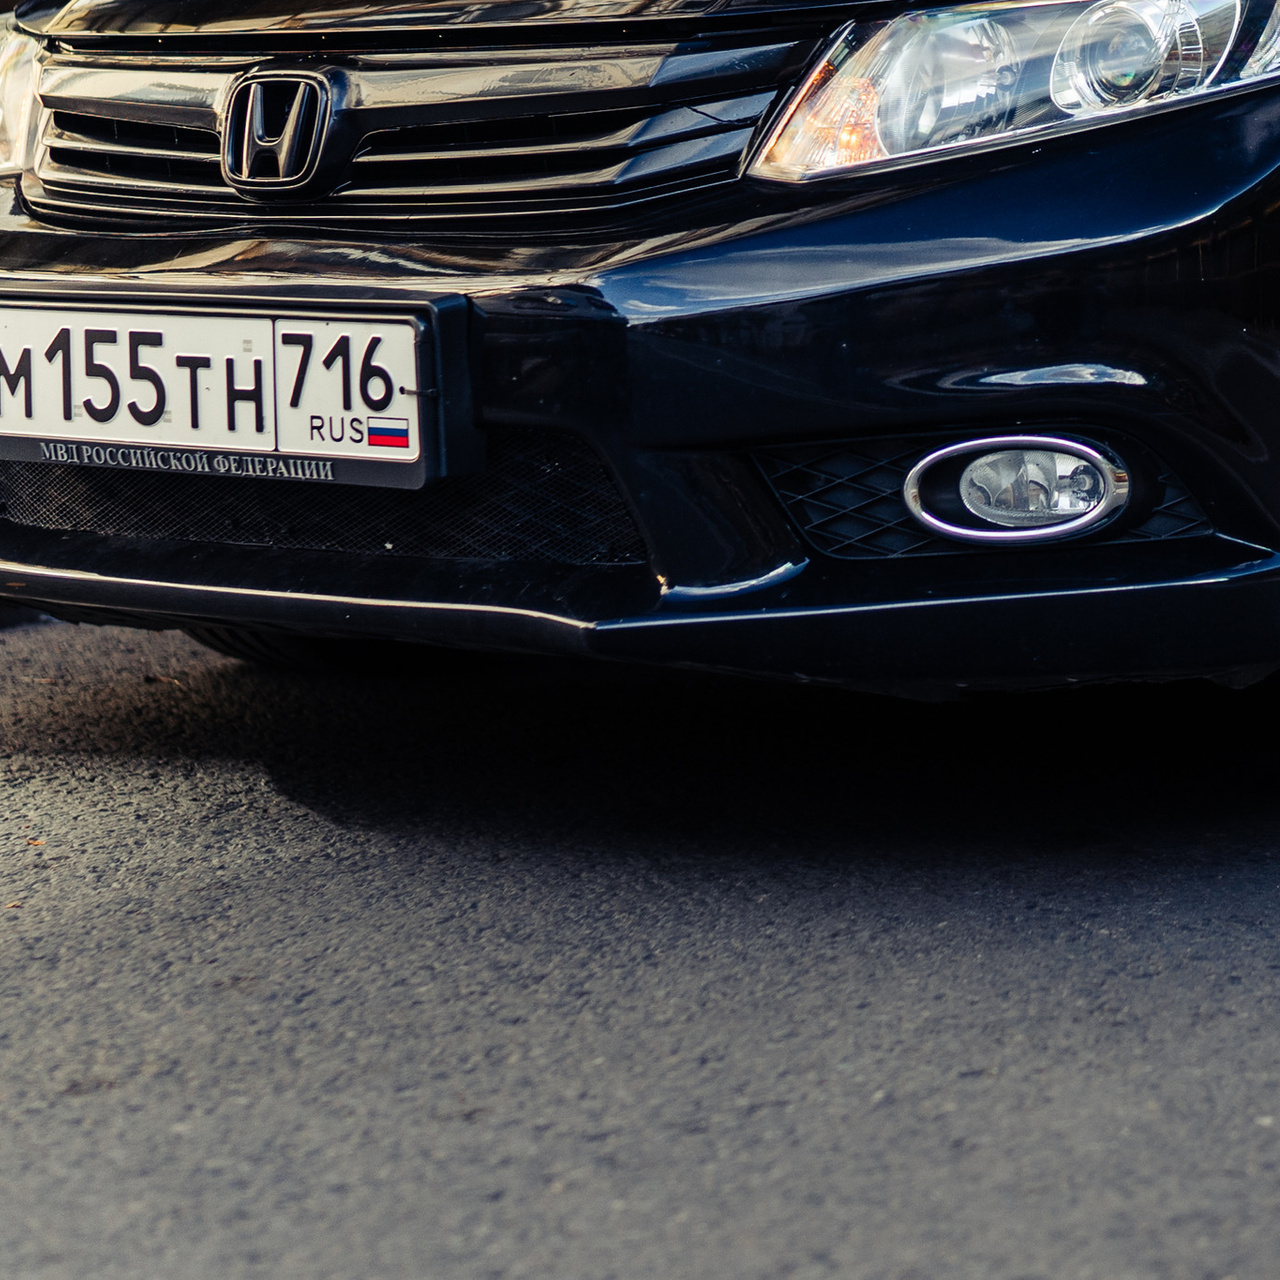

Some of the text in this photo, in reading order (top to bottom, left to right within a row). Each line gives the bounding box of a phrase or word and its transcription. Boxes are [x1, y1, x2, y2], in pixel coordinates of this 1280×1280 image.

[281, 333, 394, 412] 716
[310, 415, 364, 443] RUS
[40, 442, 335, 480] МВД РОССИЙСКОЙ ФЕДЕРАЦИИ
